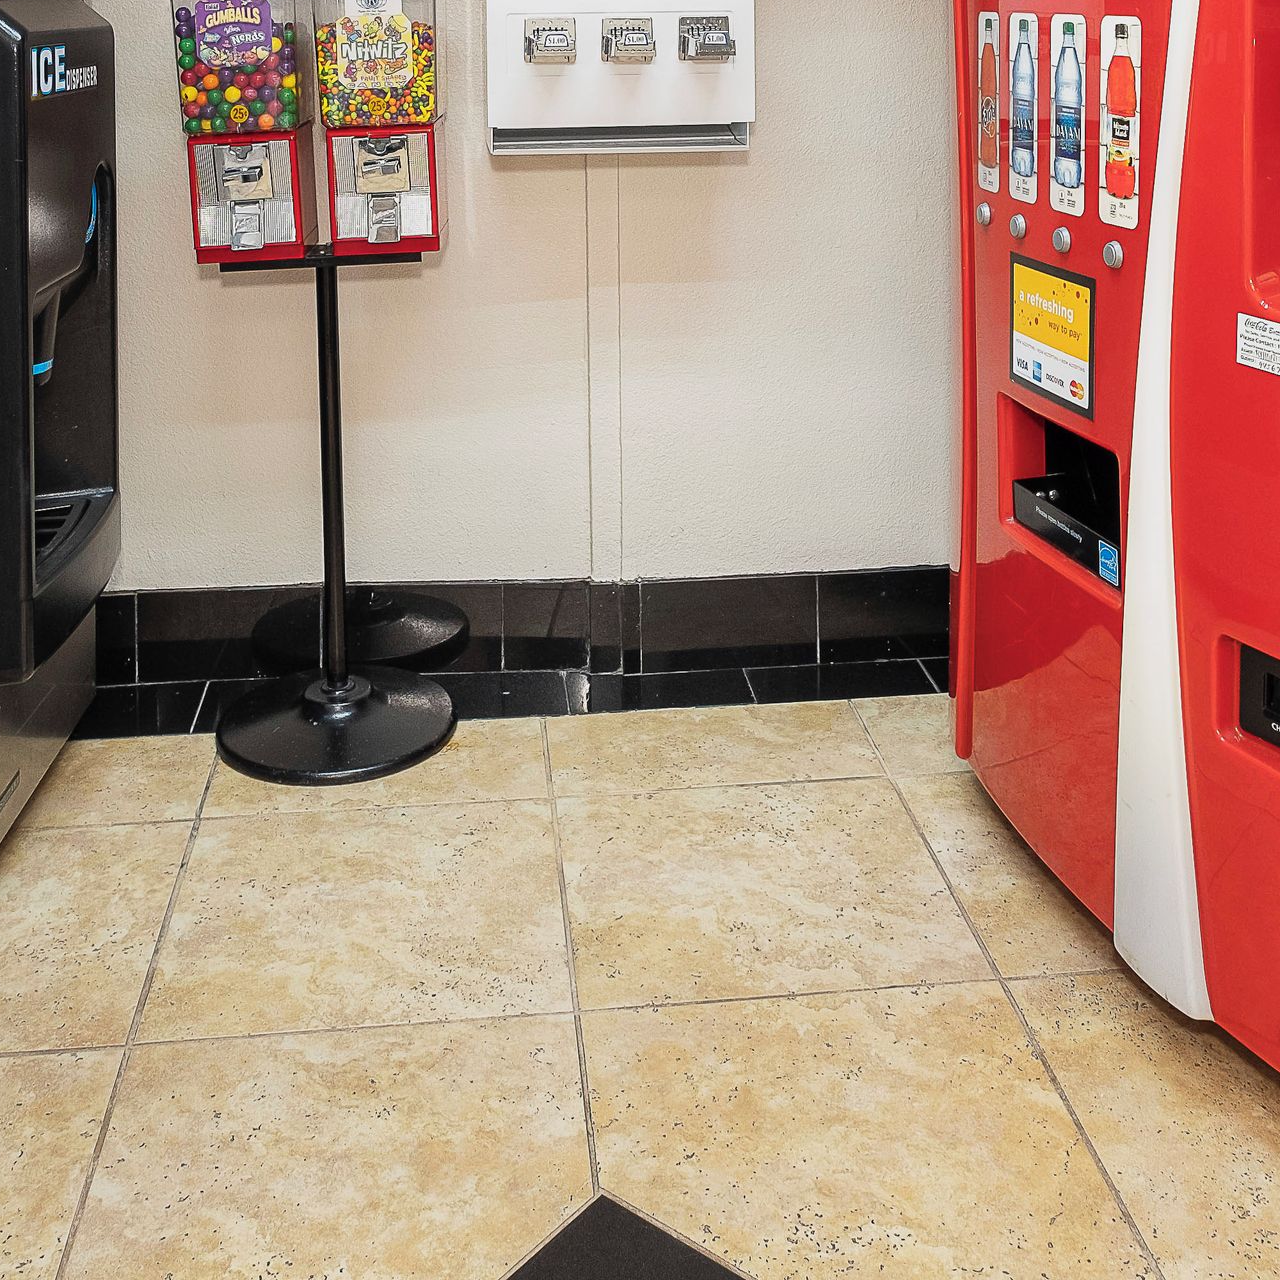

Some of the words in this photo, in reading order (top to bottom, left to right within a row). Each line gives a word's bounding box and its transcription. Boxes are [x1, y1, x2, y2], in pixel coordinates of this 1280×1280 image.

[205, 7, 261, 29] GUMBALLS
[547, 36, 566, 45] $1.00
[626, 34, 644, 43] $1.00
[706, 34, 724, 43] $1.00
[340, 38, 409, 61] NitWitz
[31, 45, 66, 97] ICE
[66, 65, 98, 91] DISPENSER
[370, 99, 387, 114] 25¢
[232, 107, 249, 122] 25¢
[1019, 290, 1025, 300] a
[1026, 291, 1074, 324] refreshing
[1048, 320, 1060, 333] way
[1061, 323, 1068, 334] to
[1069, 328, 1081, 342] pay
[1016, 357, 1029, 371] VISA
[1045, 373, 1065, 388] DISCOVER
